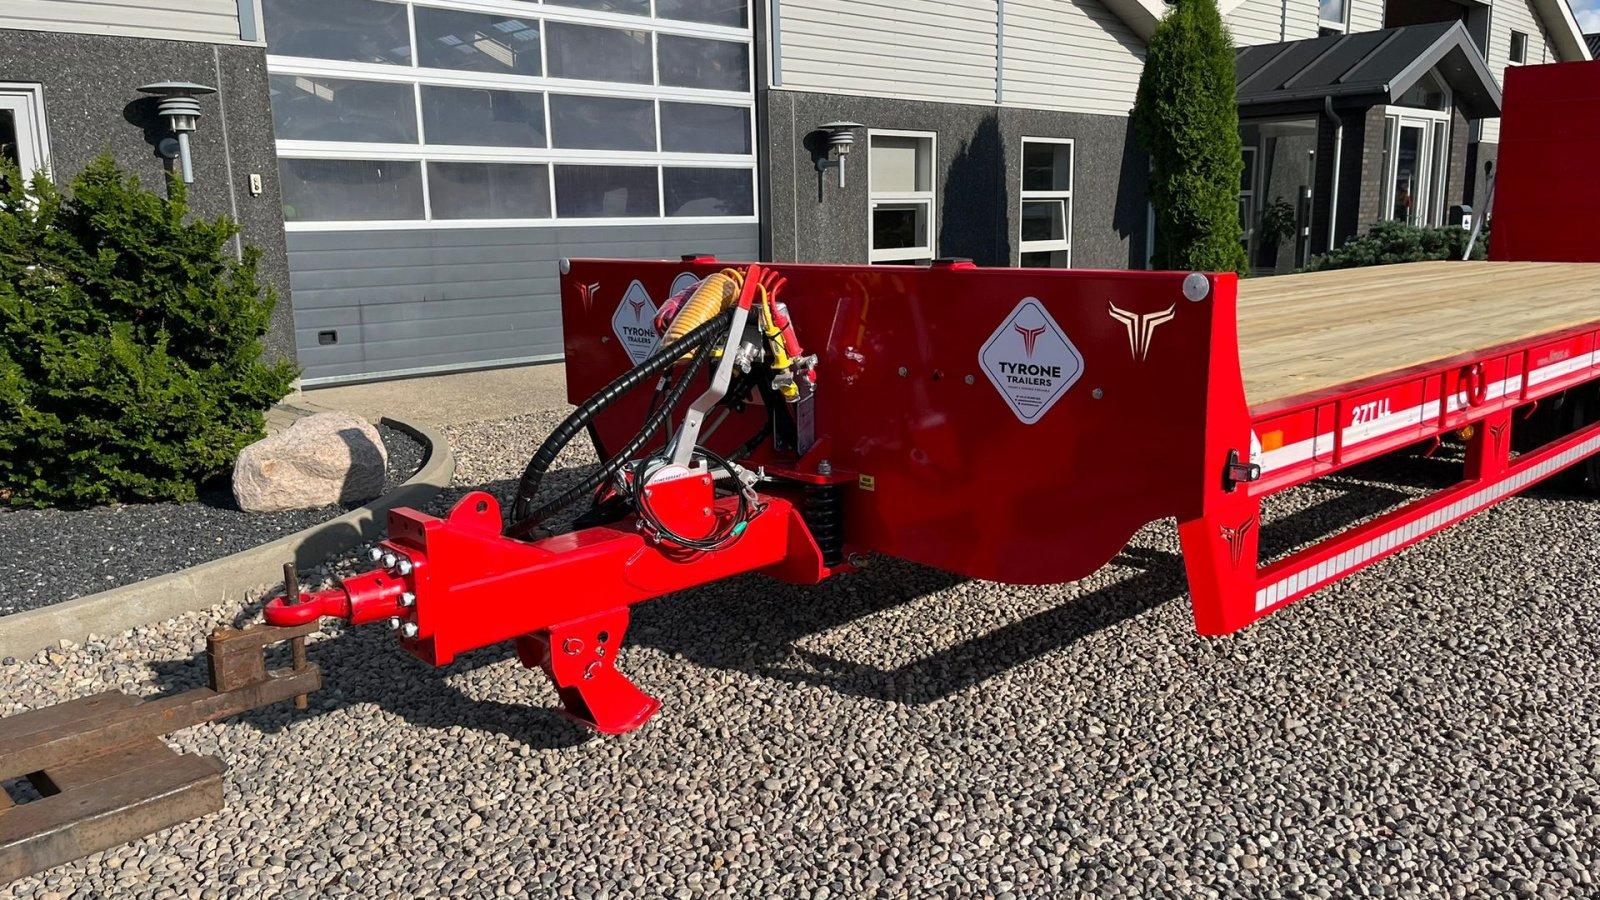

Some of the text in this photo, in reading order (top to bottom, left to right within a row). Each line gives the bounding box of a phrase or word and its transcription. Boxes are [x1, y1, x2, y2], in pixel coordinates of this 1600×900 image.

[622, 326, 656, 338] TYRONE
[627, 336, 651, 344] TRAILERS
[998, 361, 1061, 378] TYRONE
[1006, 375, 1052, 387] TRAILERS
